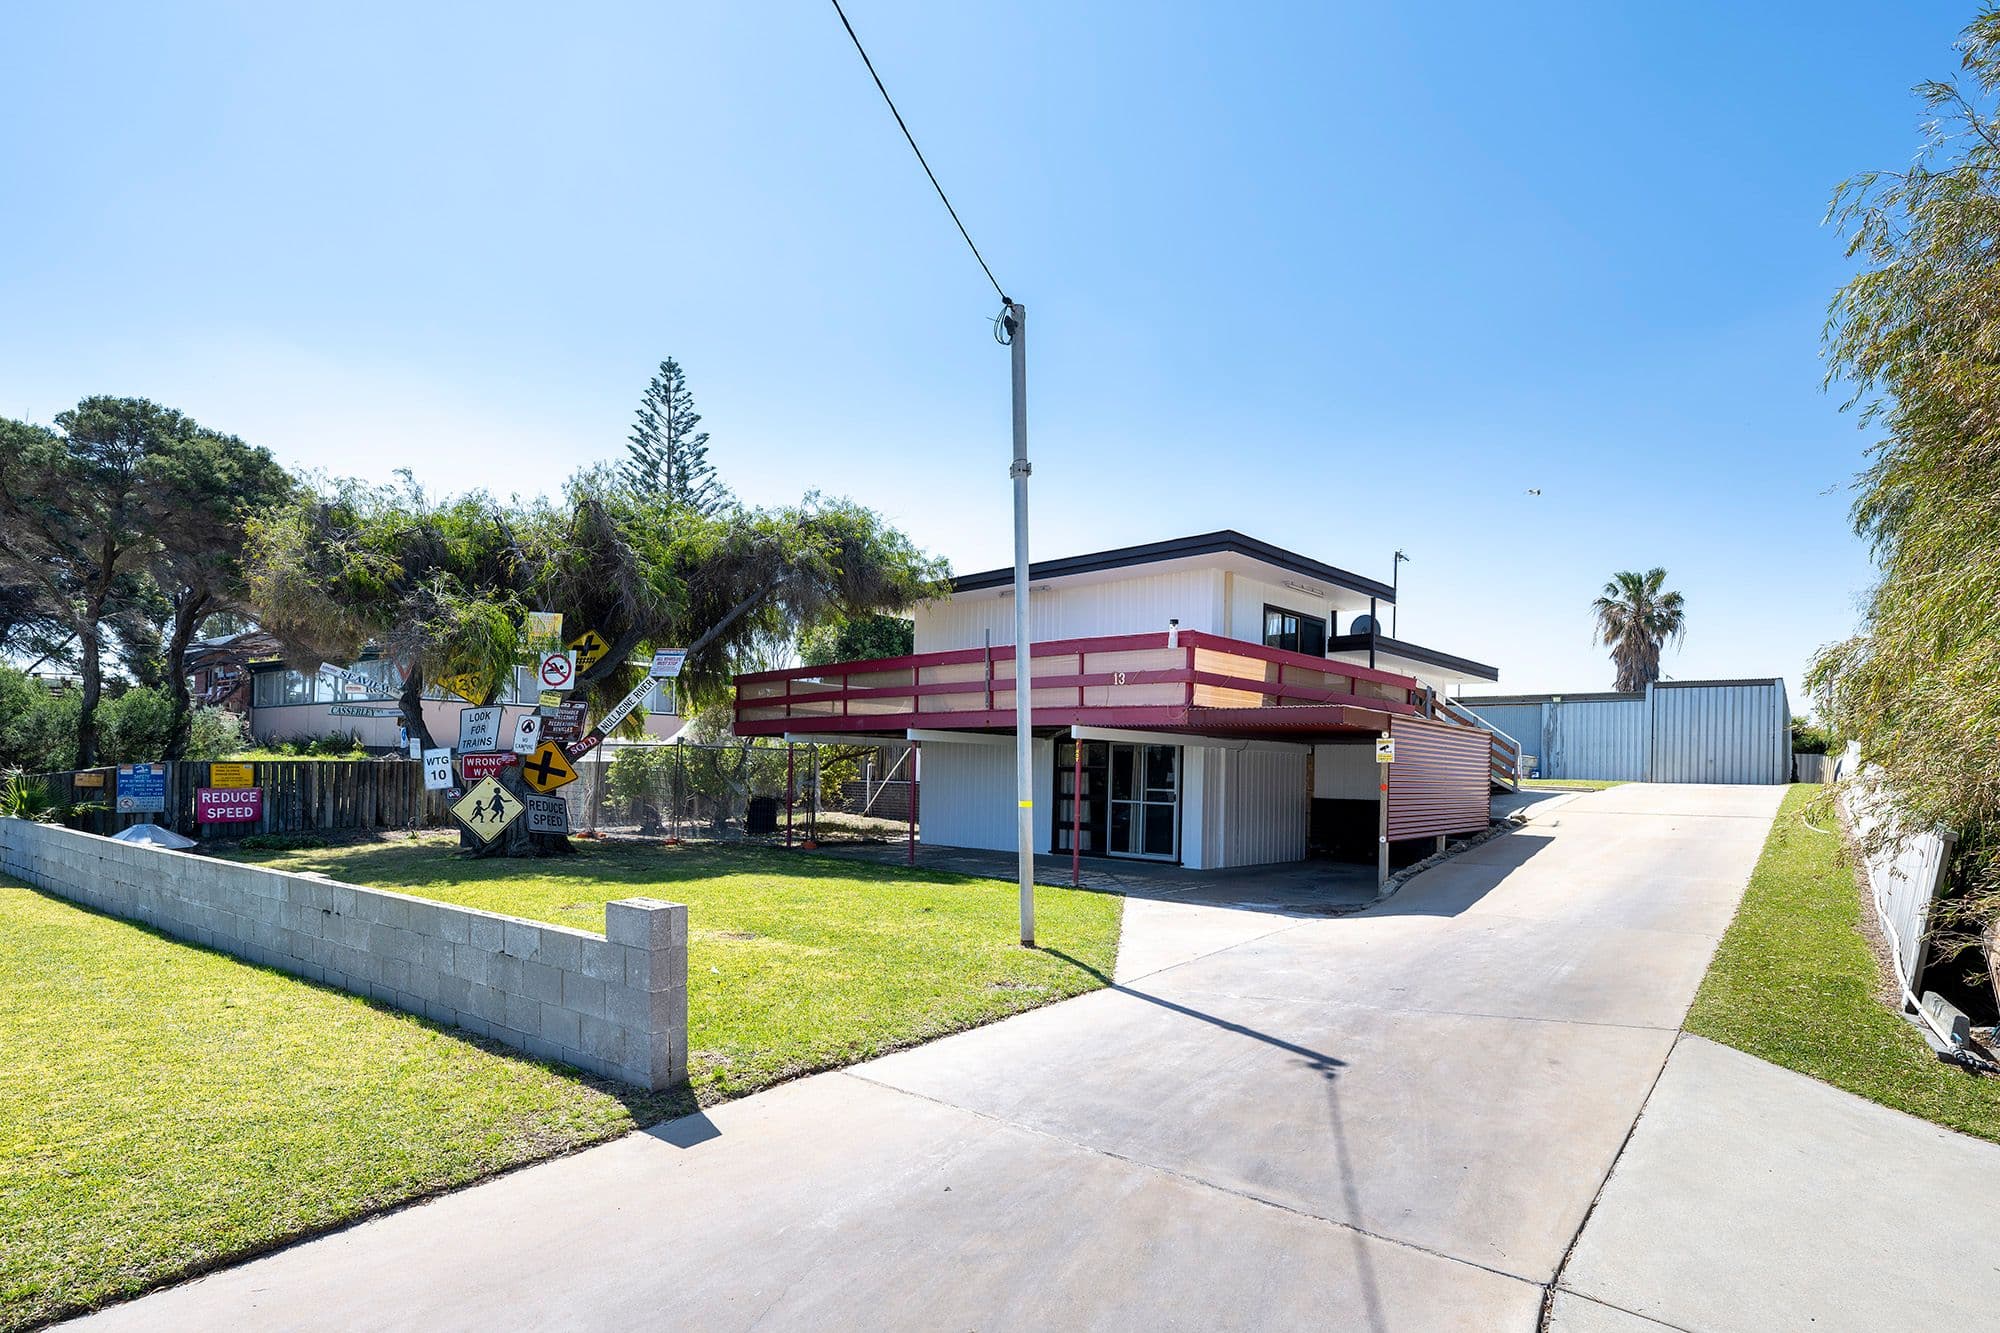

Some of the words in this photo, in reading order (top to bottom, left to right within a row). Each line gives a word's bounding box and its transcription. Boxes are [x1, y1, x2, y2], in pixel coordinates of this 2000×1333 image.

[1114, 672, 1126, 685] 13
[331, 706, 375, 716] CASSERLEY
[600, 697, 636, 732] NULLAGINE
[633, 679, 655, 699] RIVER
[469, 711, 492, 723] LOOK
[471, 725, 486, 735] FOR
[462, 737, 492, 749] TRAINS
[570, 736, 597, 755] SOLD
[426, 756, 450, 767] WTG
[431, 770, 447, 781] 10
[473, 768, 497, 776] WAY
[202, 792, 258, 803] REDUCE
[207, 807, 254, 818] SPEED
[529, 800, 564, 814] REDUCE
[533, 815, 563, 827] SPEED
